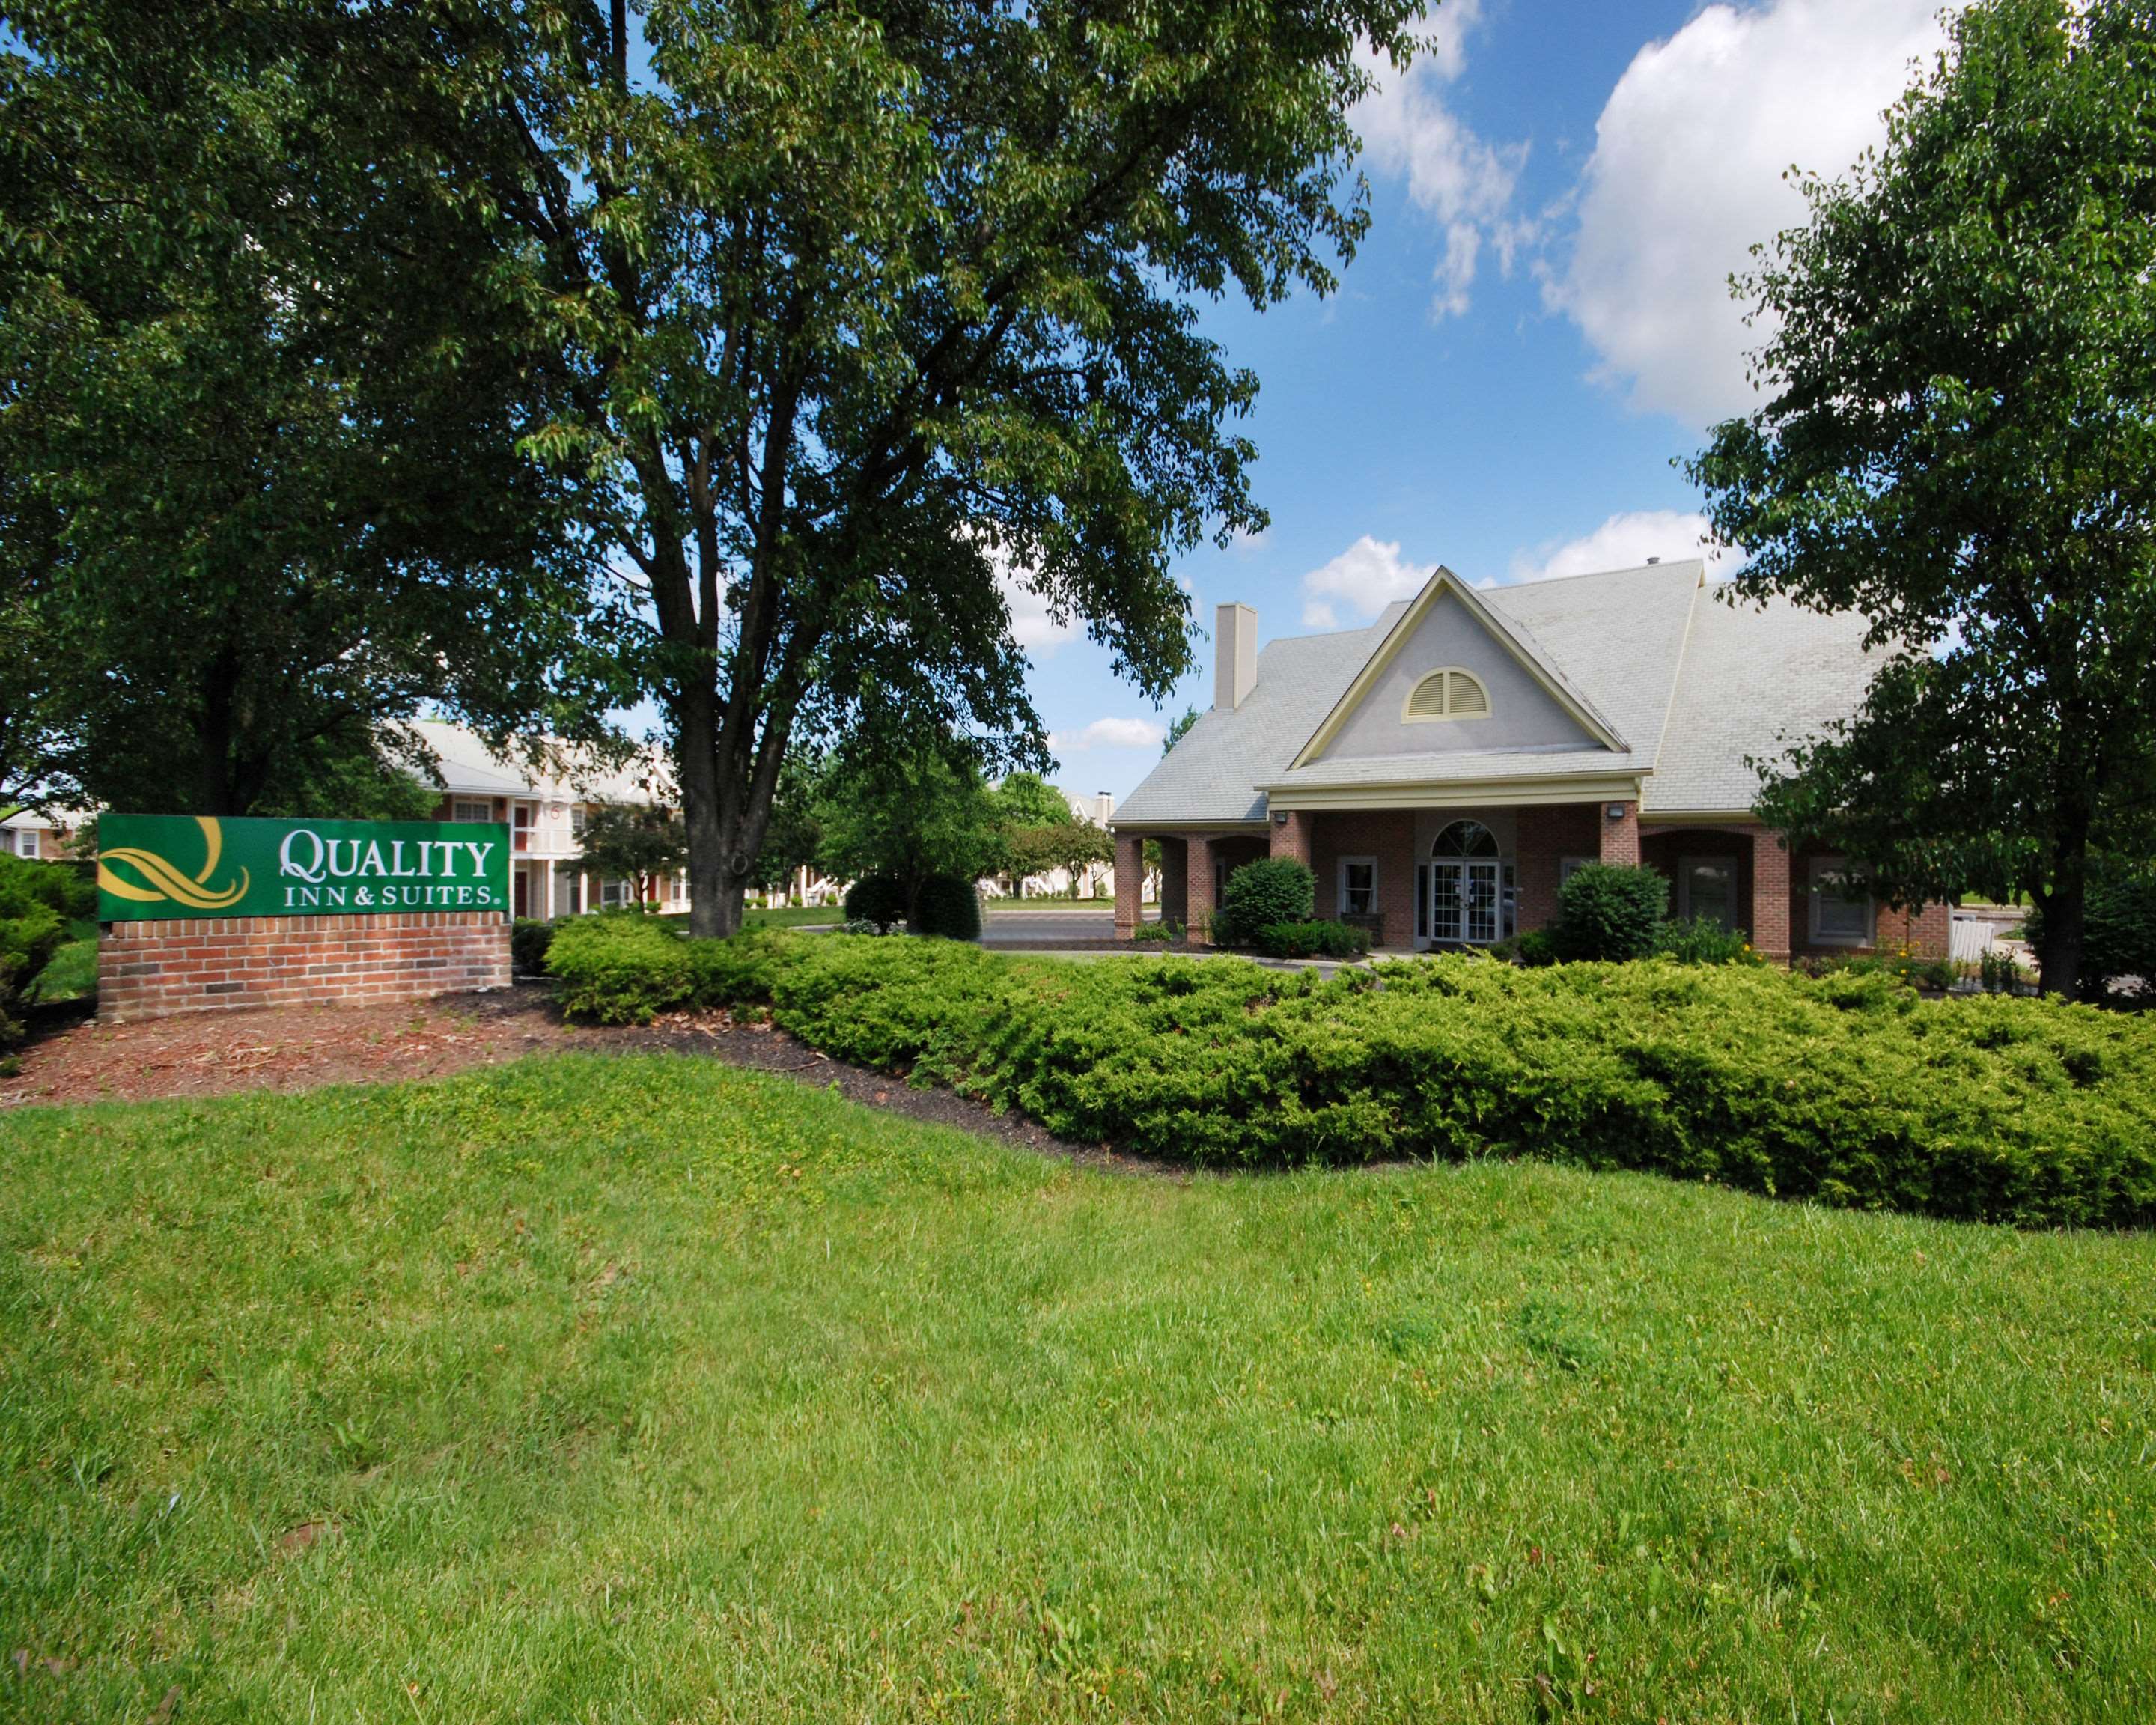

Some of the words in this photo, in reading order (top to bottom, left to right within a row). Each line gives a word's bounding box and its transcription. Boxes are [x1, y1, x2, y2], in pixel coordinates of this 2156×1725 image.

[280, 829, 495, 883] QUALITY
[284, 886, 347, 906] INN
[354, 886, 375, 905] &
